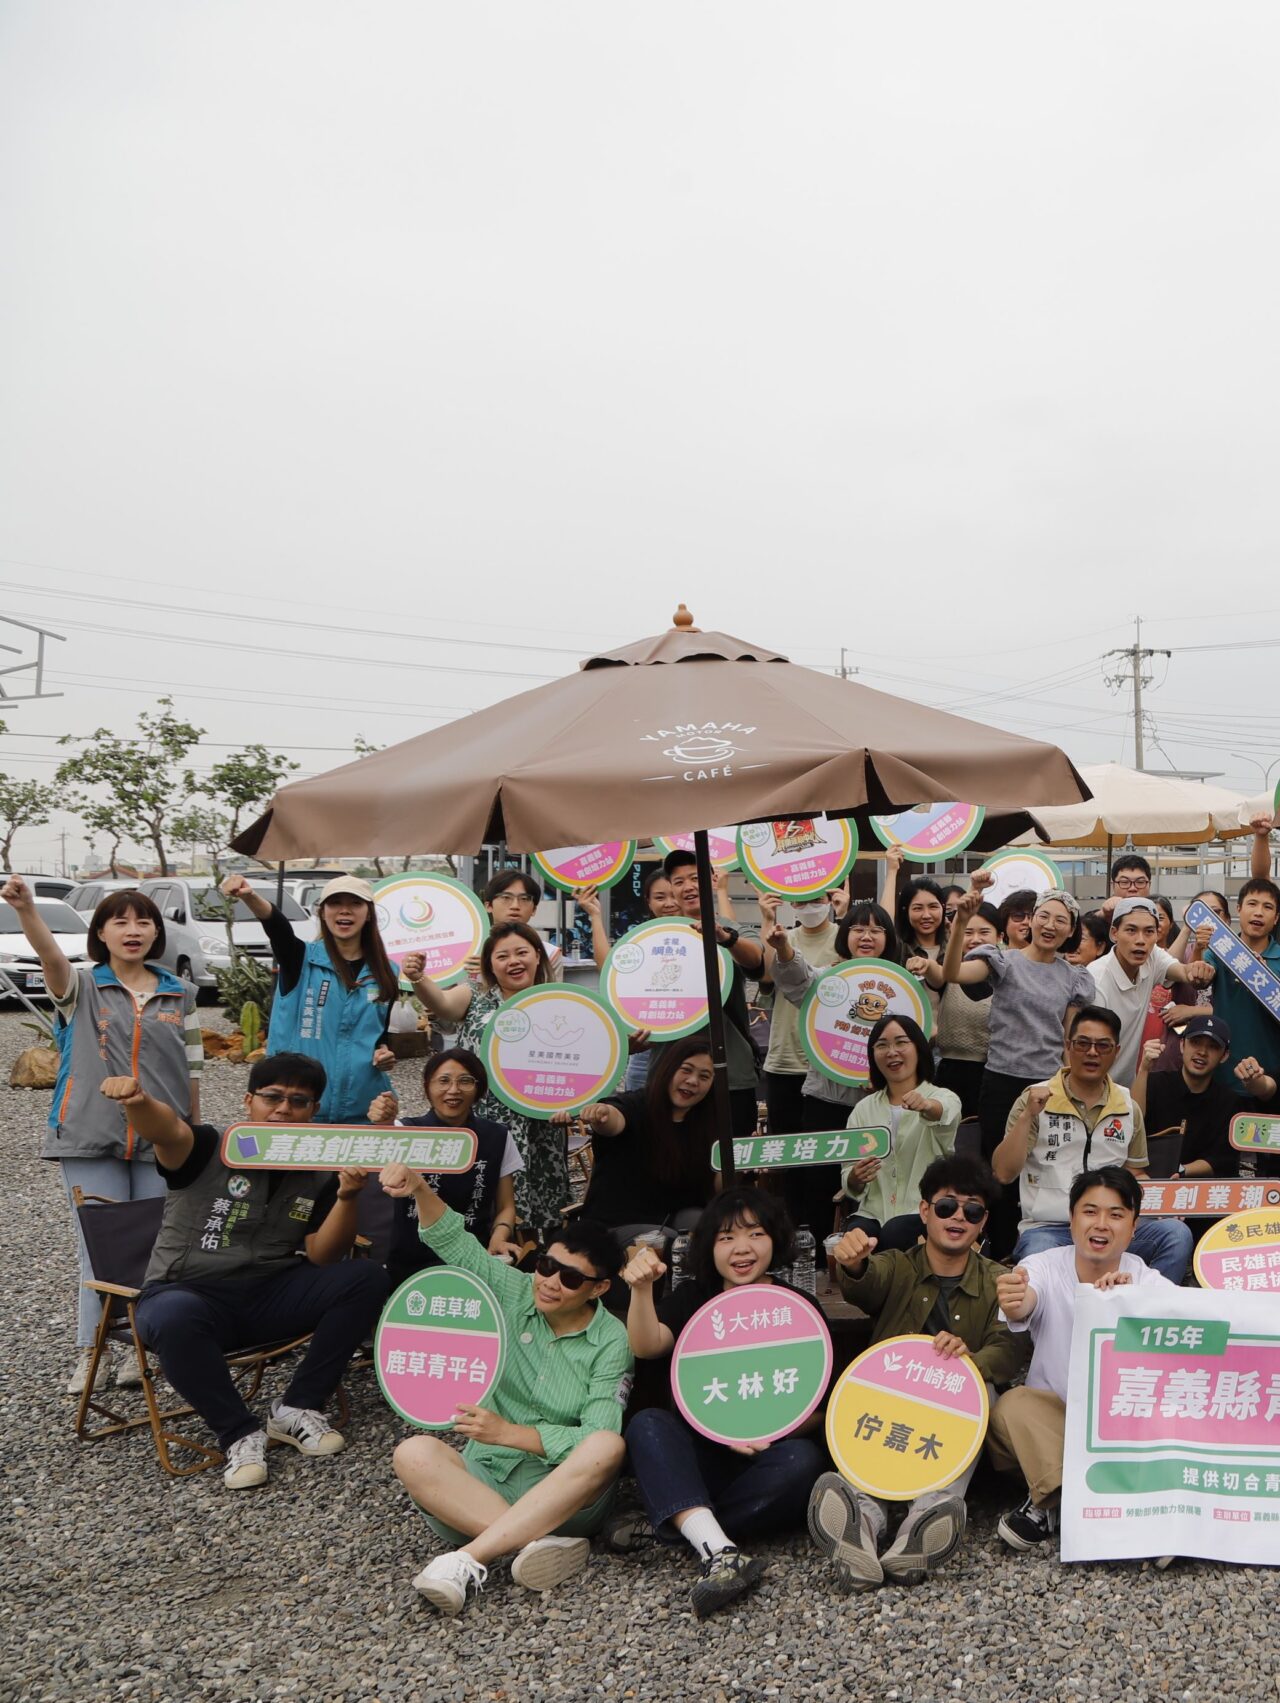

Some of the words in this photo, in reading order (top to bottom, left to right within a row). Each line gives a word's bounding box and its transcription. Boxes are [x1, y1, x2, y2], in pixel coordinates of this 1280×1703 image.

[639, 721, 758, 741] YAMAHA
[683, 763, 733, 782] CAFÉ
[262, 1133, 466, 1167] 嘉義創業新風潮
[733, 1135, 850, 1165] 創業培力
[1140, 1185, 1265, 1210] 嘉創業潮
[200, 1197, 233, 1250] 蔡承佑
[428, 1296, 482, 1320] 鹿草鄉
[728, 1305, 793, 1333] 大林鎮
[1140, 1325, 1205, 1349] 115年
[385, 1349, 489, 1385] 鹿草青平台
[905, 1359, 968, 1395] 竹崎鄉
[702, 1367, 800, 1406] 大林好
[853, 1412, 944, 1461] 佇嘉木
